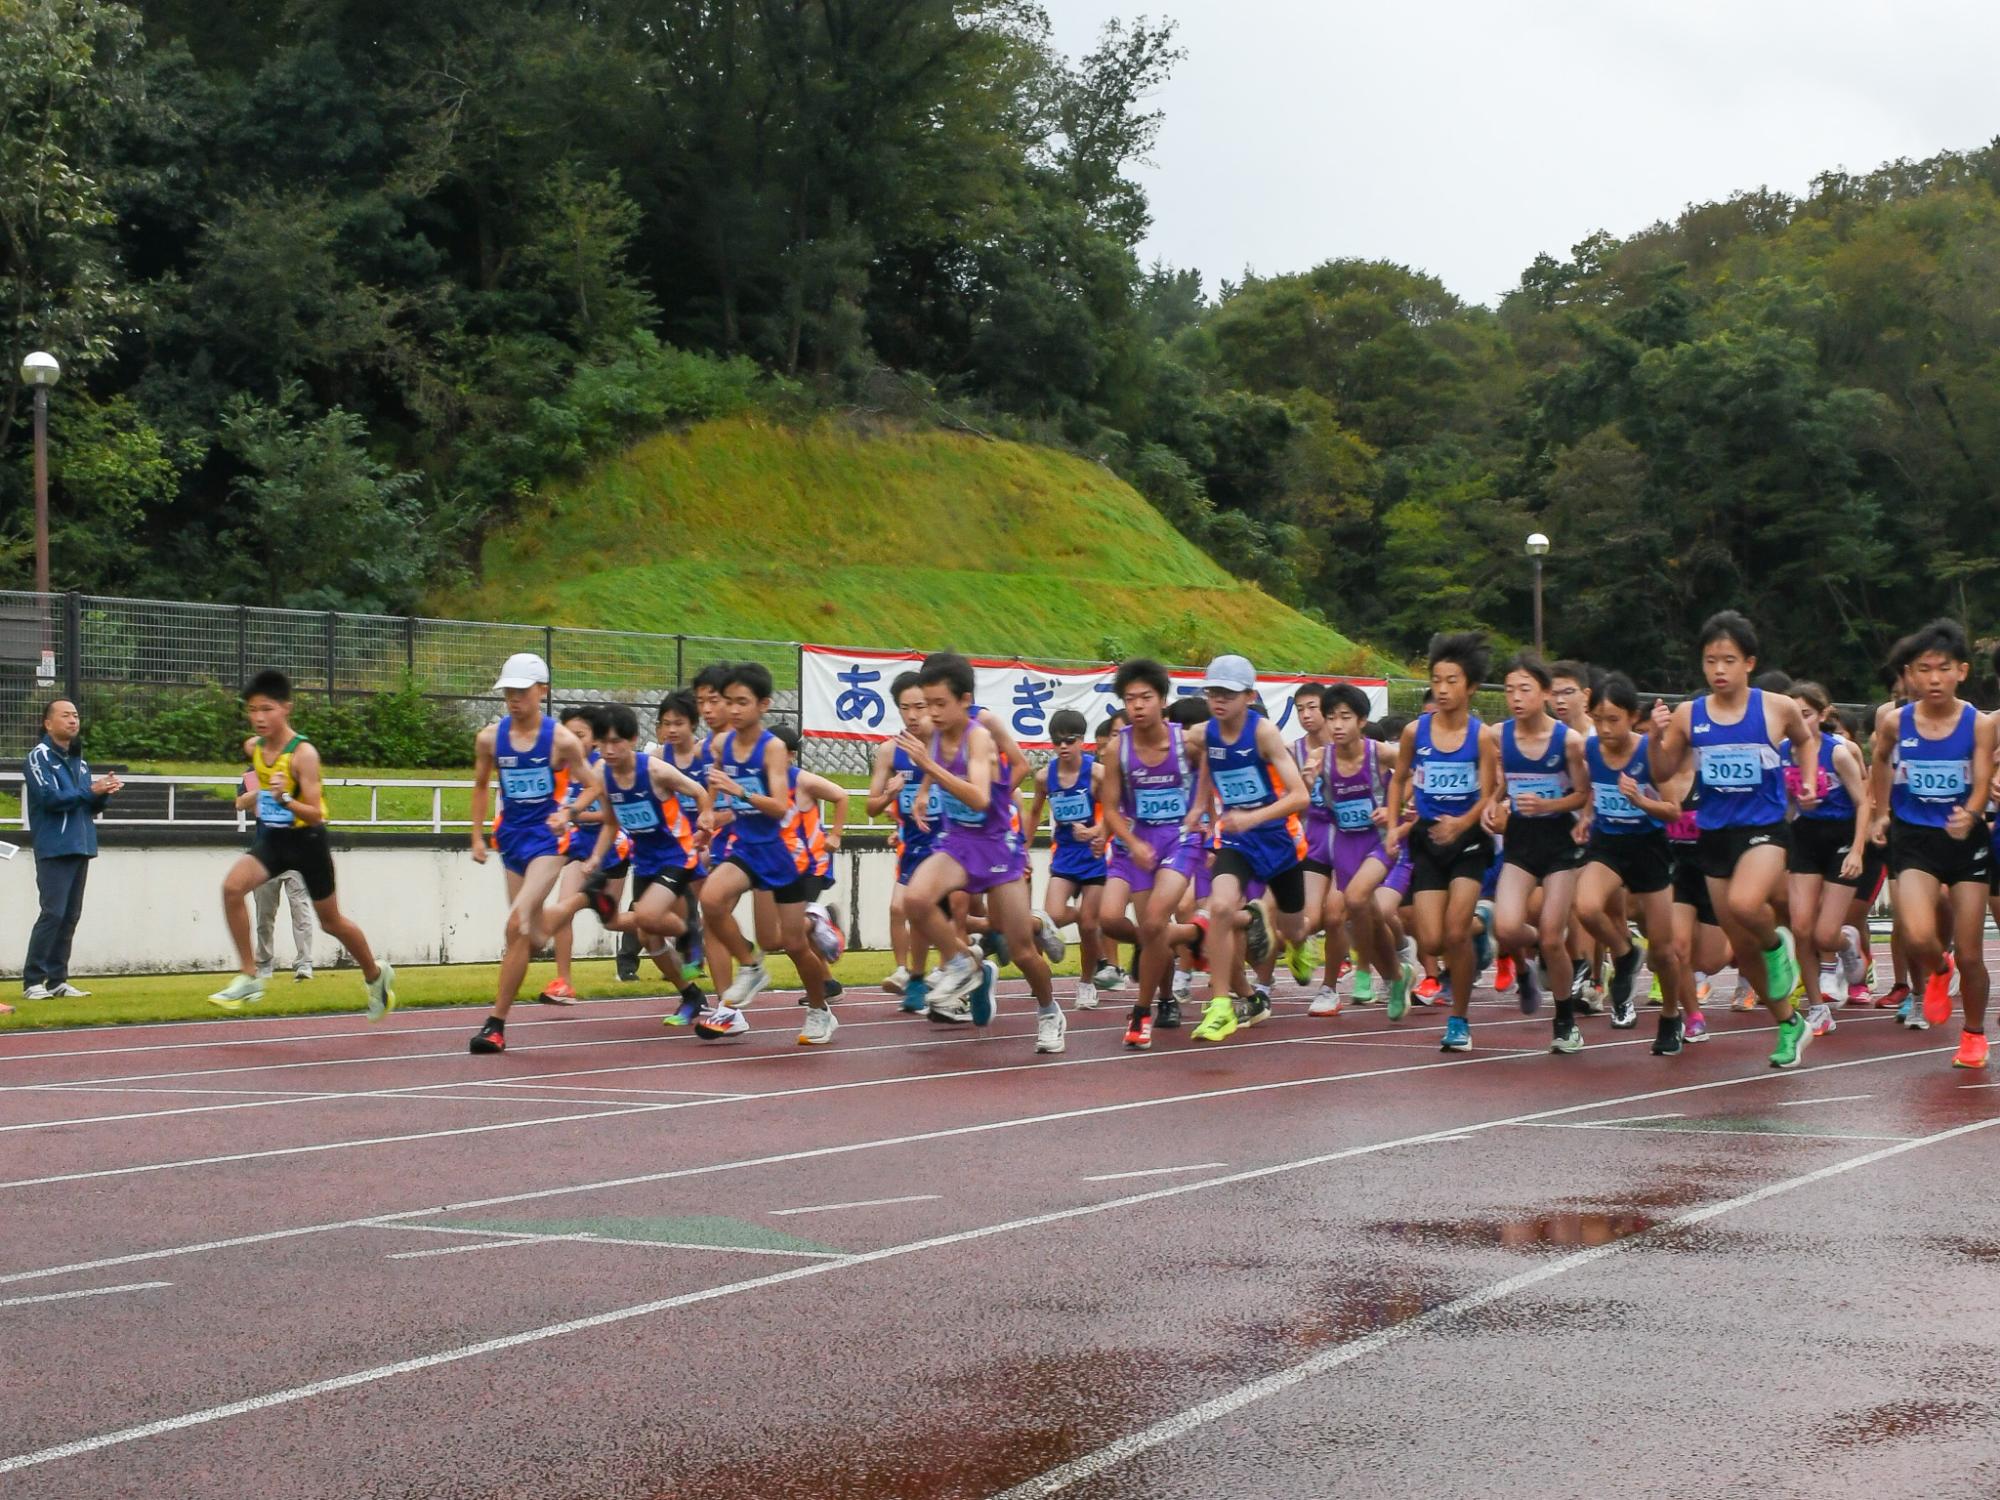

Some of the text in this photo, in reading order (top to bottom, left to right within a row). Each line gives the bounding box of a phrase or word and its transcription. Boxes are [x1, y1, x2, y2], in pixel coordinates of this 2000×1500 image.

[1709, 763, 1753, 779] 3025
[1222, 780, 1257, 798] 3013
[1429, 774, 1468, 789] 3024
[1913, 773, 1958, 789] 3026
[1055, 803, 1084, 817] 3007
[1141, 798, 1180, 814] 3046
[1600, 795, 1637, 811] 302
